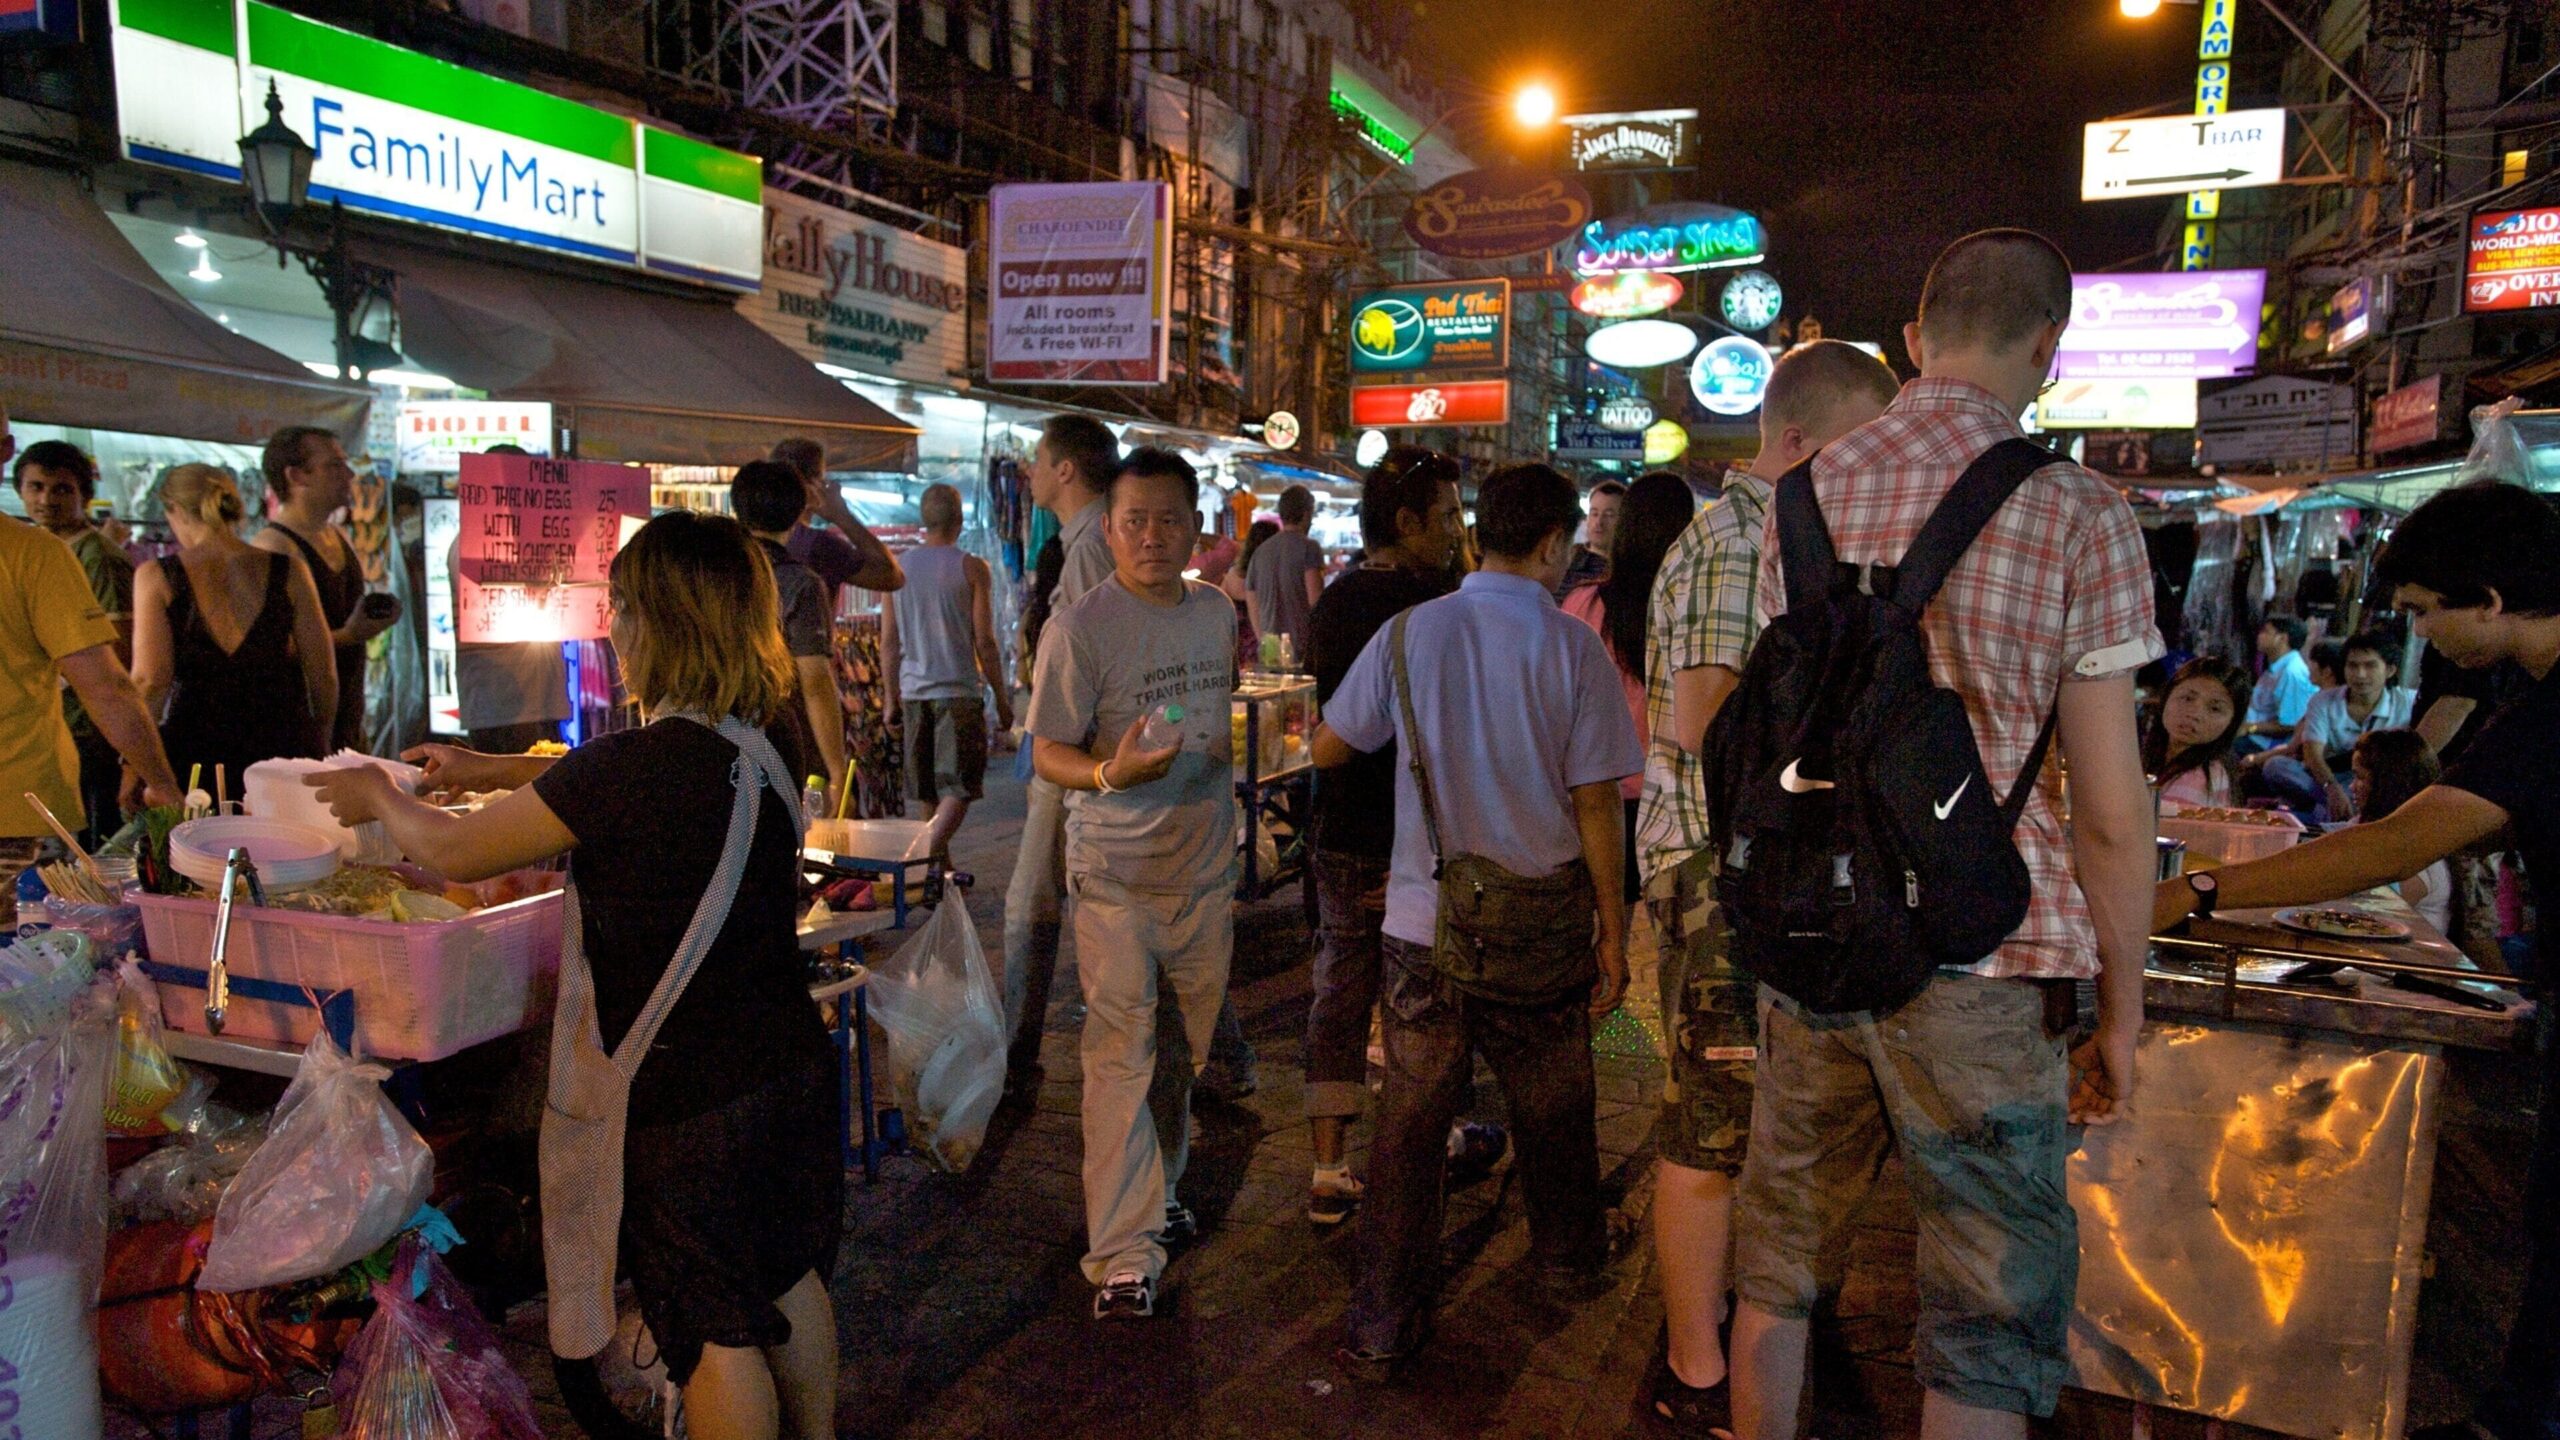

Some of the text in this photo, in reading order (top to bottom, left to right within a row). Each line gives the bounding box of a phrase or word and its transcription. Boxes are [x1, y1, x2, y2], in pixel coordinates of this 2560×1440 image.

[1582, 131, 1617, 162] JACK
[2107, 128, 2131, 154] Z
[312, 97, 606, 227] FamilyMart
[2505, 211, 2560, 235] DIO
[853, 229, 966, 314] House
[1003, 270, 1061, 292] Open
[1067, 271, 1114, 287] now
[1024, 305, 1116, 320] All rooms
[1424, 290, 1504, 318] Pad Thai
[1007, 322, 1134, 335] included breakfast
[1427, 315, 1498, 327] RESTAURANT
[1022, 338, 1033, 350] &
[1040, 337, 1075, 349] Free
[1600, 406, 1653, 425] TATTOO
[1593, 436, 1637, 448] Silver
[529, 462, 571, 484] MENU
[491, 486, 522, 508] THAI
[524, 487, 543, 508] NO
[544, 489, 572, 510] EGG
[597, 490, 617, 514] 25
[484, 514, 520, 537] WITH
[542, 515, 570, 538] EGG
[594, 516, 616, 539] 30
[483, 541, 520, 564] WITH
[1143, 663, 1188, 686] WORK
[1133, 684, 1191, 706] TRAVEL
